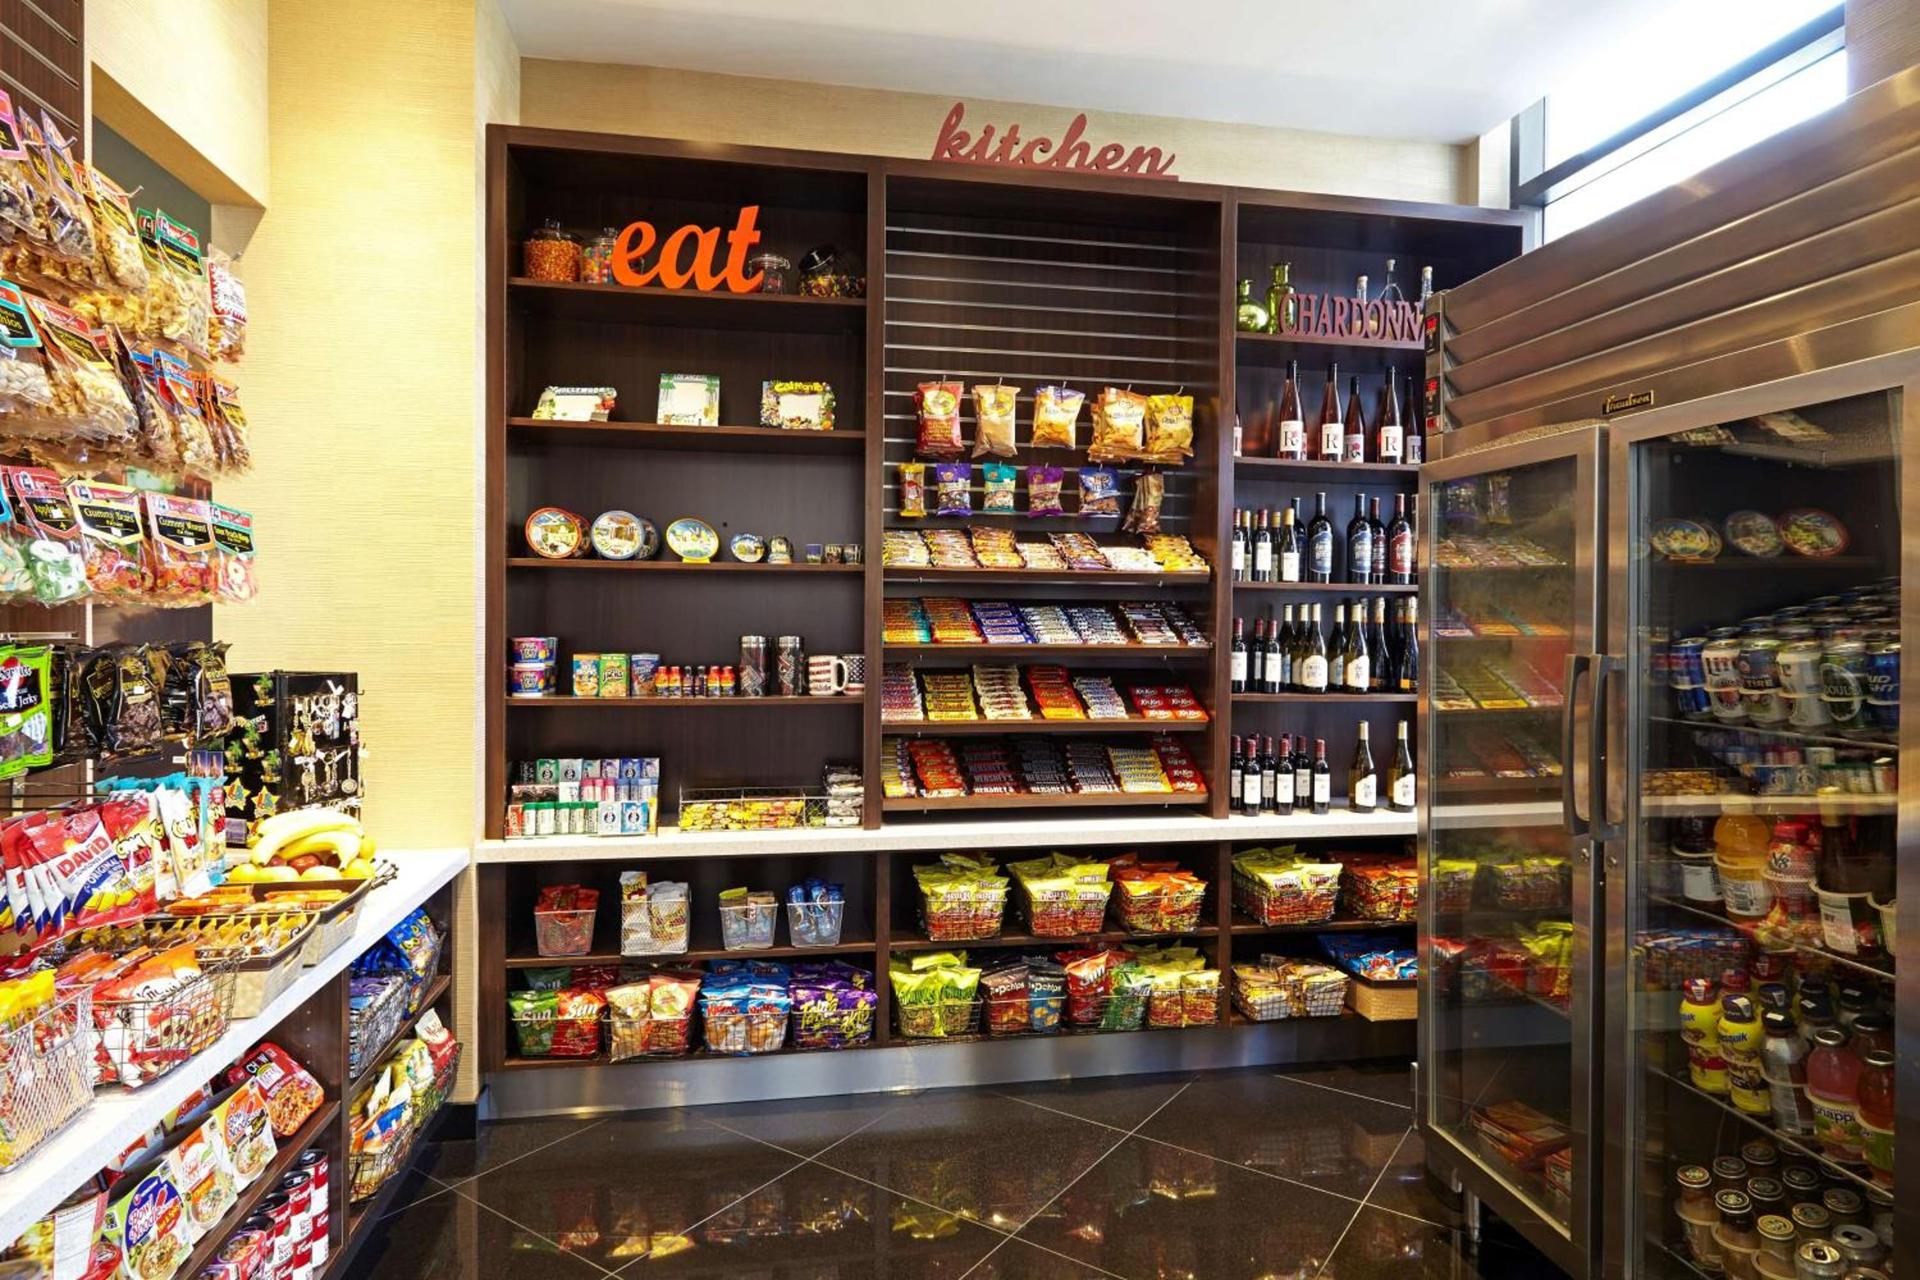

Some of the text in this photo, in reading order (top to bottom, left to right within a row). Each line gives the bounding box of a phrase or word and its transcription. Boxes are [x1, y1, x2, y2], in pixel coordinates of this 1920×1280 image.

[932, 102, 1177, 178] kitchen
[611, 205, 764, 293] eat
[1279, 292, 1426, 341] CHARDONN
[19, 693, 38, 708] Jerky
[57, 837, 110, 878] DAVID
[87, 857, 119, 884] ORIGINAL
[519, 1009, 552, 1027] Sun
[568, 1003, 598, 1019] Sun
[128, 1194, 155, 1225] Bow
